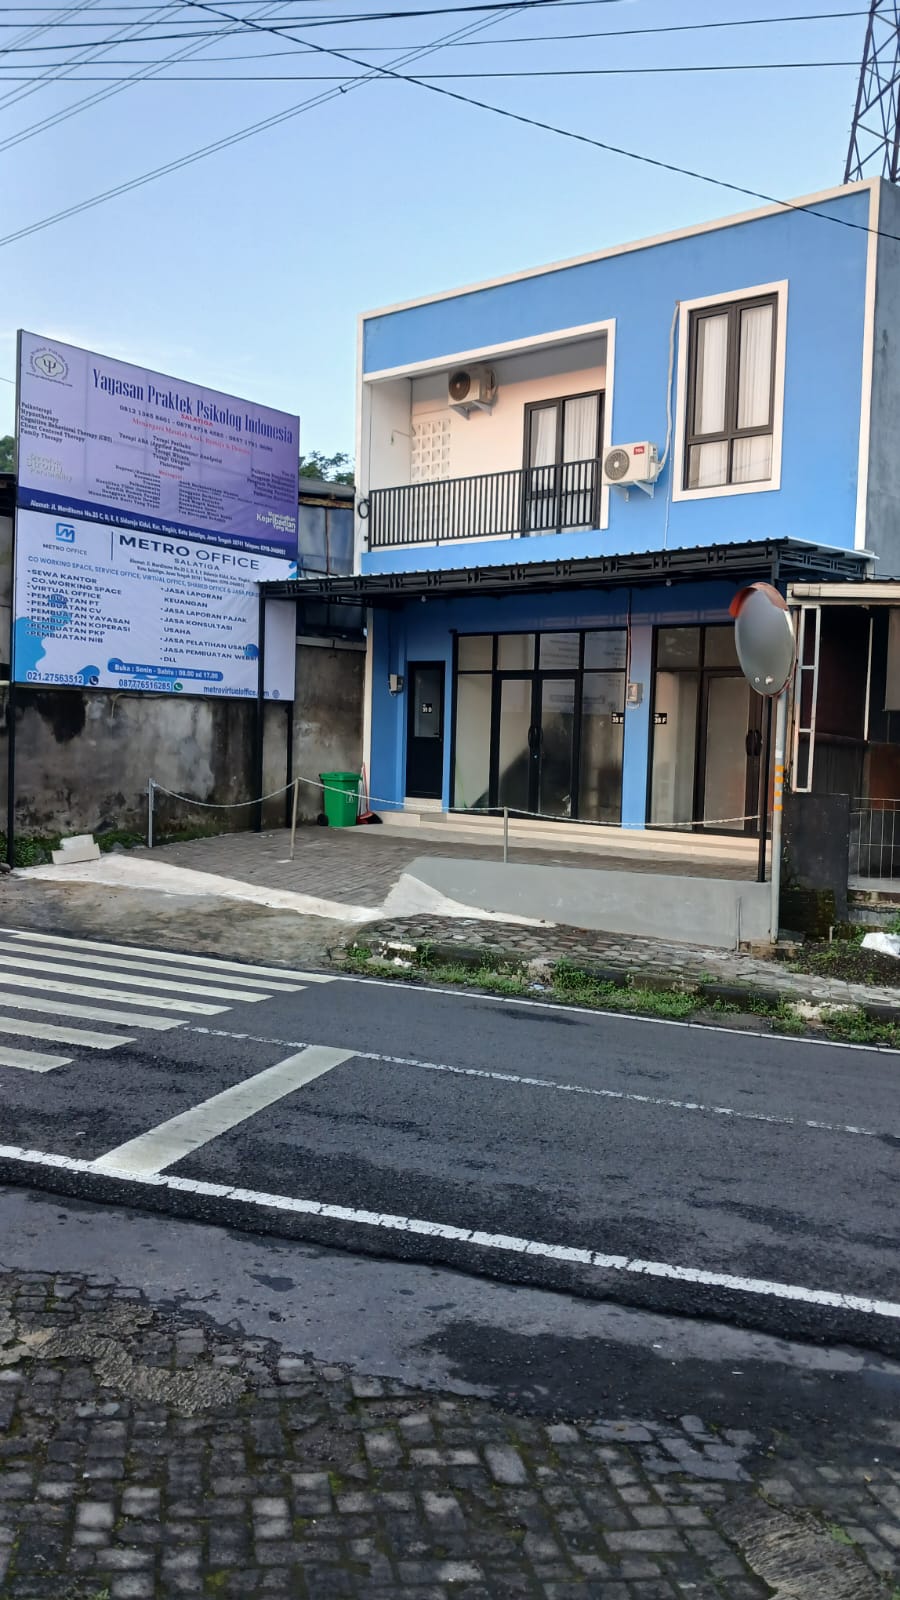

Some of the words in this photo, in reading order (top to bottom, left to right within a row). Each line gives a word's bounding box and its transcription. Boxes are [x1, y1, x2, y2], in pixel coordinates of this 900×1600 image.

[21, 402, 52, 415] Psikoterapi
[93, 368, 144, 401] Yayasan
[148, 384, 192, 416] Praktek
[197, 399, 241, 432] Psikolog
[245, 414, 293, 444] Indonesia
[21, 415, 47, 426] Cognitive
[77, 428, 98, 440] Therapy
[180, 414, 213, 427] SALATIGA
[21, 421, 38, 431] Client
[39, 424, 63, 436] Centered
[64, 430, 85, 443] Therapy
[21, 428, 39, 438] Family
[41, 433, 63, 443] Therapy
[42, 543, 64, 552] METRO
[66, 547, 87, 556] OFFICE
[119, 534, 190, 557] METRO
[196, 550, 259, 570] OFFICE
[40, 557, 71, 567] WORKING
[72, 563, 93, 571] SPACE,
[95, 566, 119, 575] SERVICE
[174, 558, 220, 571] SALATIGA
[31, 569, 58, 578] SEWA
[60, 572, 97, 584] KANTOR
[31, 577, 92, 591] CO.WORKING
[94, 585, 122, 595] SPACE
[31, 585, 68, 595] VIRTUAL
[71, 590, 101, 599] OFFICE
[31, 592, 87, 605] PEMBUATAN
[164, 587, 185, 596] JASA
[187, 591, 222, 601] LAPORAN
[31, 600, 87, 613] PEMBUATAN
[164, 597, 208, 608] KEUANGAN
[31, 608, 87, 619] PEMBUATAN
[89, 614, 130, 625] YAYASAN
[164, 607, 185, 616] JASA
[186, 611, 222, 620] LAPORAN
[223, 615, 247, 623] PAJAK
[31, 616, 87, 627] PEMBUATAN
[89, 622, 131, 632] KOPERASI
[31, 623, 86, 634] PEMBUATAN
[164, 617, 184, 625] JASA
[186, 621, 233, 631] KONSULTASI
[164, 627, 191, 635] USAHA
[31, 631, 86, 642] PEMBUATAN
[186, 640, 227, 649] PELATIHAN
[186, 649, 232, 659] PEMBUATAN
[27, 672, 83, 683] 021.27563512
